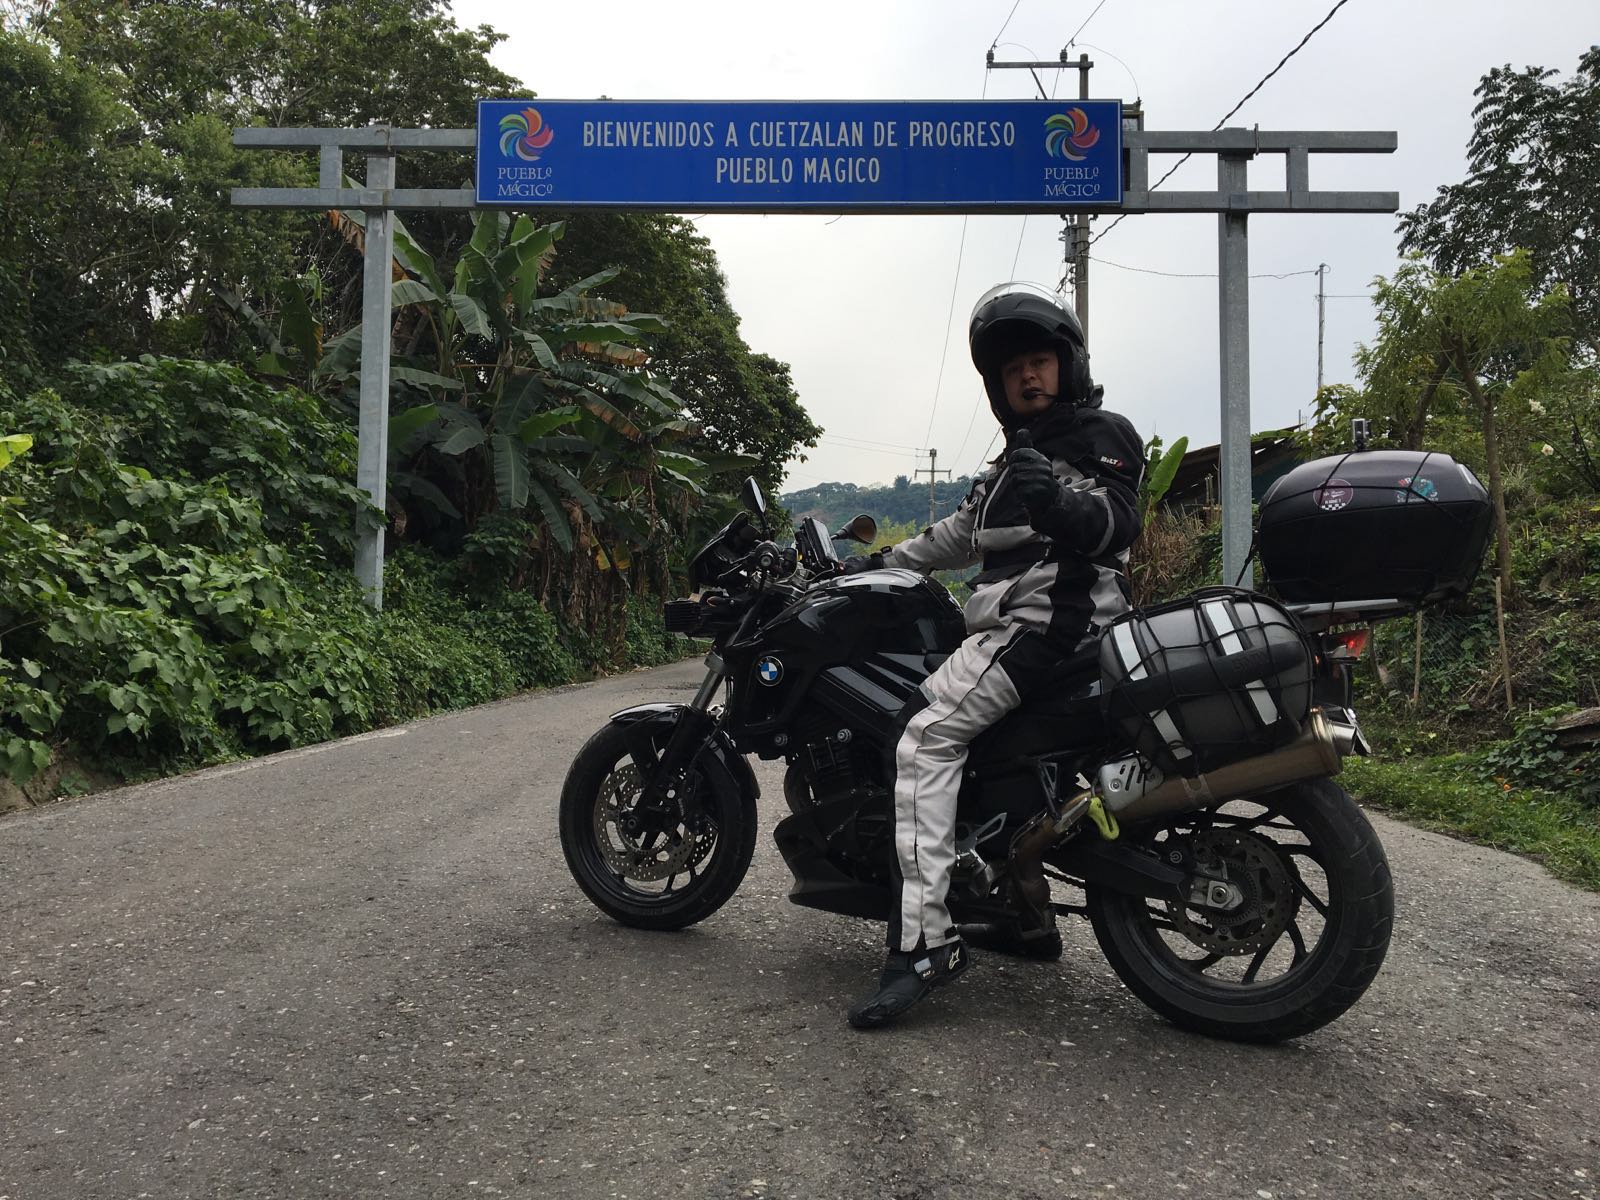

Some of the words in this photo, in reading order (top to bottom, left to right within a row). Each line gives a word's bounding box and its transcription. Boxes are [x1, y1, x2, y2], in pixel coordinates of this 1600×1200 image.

[583, 121, 714, 147] BIENVENIDOS
[725, 121, 738, 147] A
[749, 121, 863, 147] CUETZALAN
[873, 121, 898, 147] DE
[909, 121, 1015, 147] PROGRESO
[497, 167, 552, 180] PUEBLO
[716, 157, 793, 184] PUEBLO
[804, 157, 880, 183] MAGICO
[1044, 167, 1099, 180] PUEBLO
